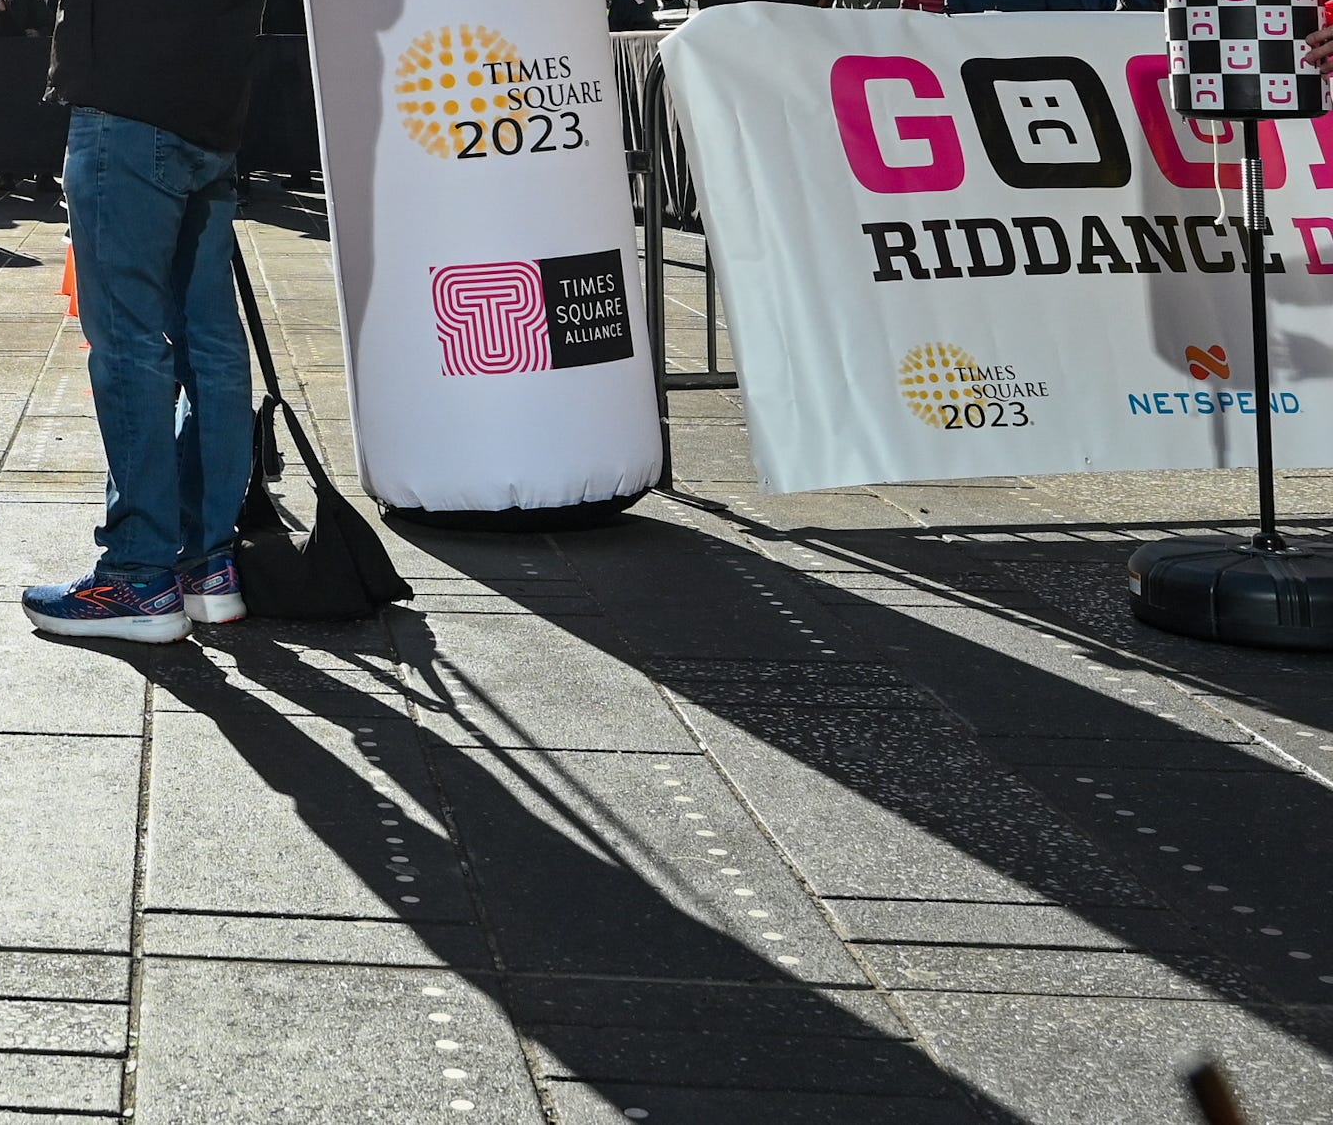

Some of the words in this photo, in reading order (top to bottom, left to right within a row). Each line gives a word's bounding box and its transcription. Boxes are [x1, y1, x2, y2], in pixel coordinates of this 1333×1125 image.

[483, 54, 572, 87] TIMES
[507, 79, 604, 114] SQUARE
[455, 111, 584, 160] 2023
[831, 54, 1333, 193] GOO
[862, 214, 1286, 282] RIDDANCE
[559, 273, 615, 298] TIMES
[556, 297, 623, 325] SQUARE
[564, 321, 623, 345] ALLIANCE
[954, 364, 1016, 382] TIMES
[972, 381, 1050, 401] SQUARE
[1129, 391, 1301, 415] NETSPEND
[942, 400, 1030, 431] 2023
